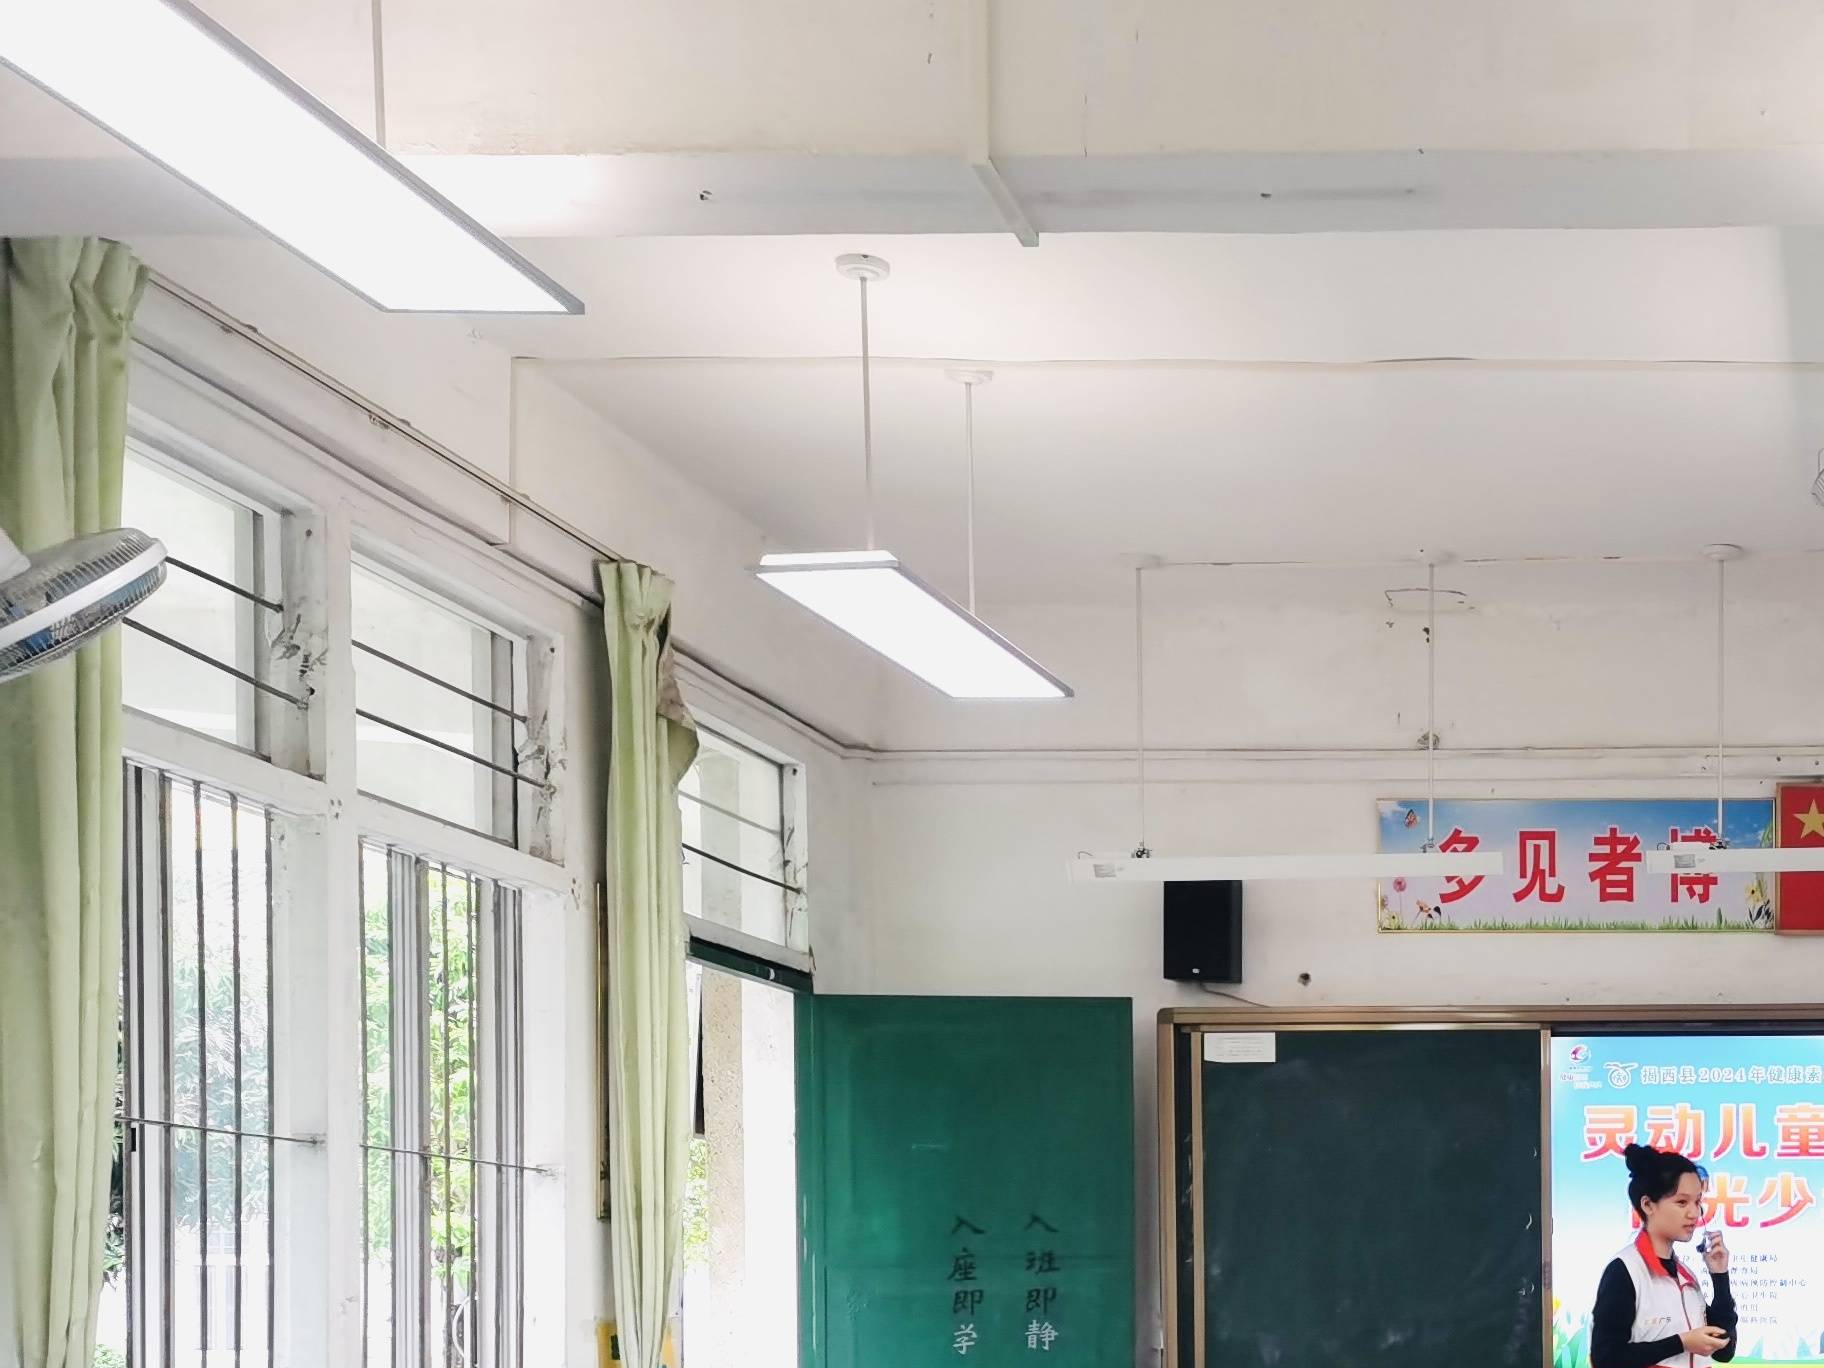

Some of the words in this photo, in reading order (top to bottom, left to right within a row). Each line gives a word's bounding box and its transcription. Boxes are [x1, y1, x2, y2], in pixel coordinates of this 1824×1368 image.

[1438, 825, 1719, 904] 多见者博
[946, 1213, 986, 1356] 入座即学
[1023, 1212, 1062, 1351] 入班即静
